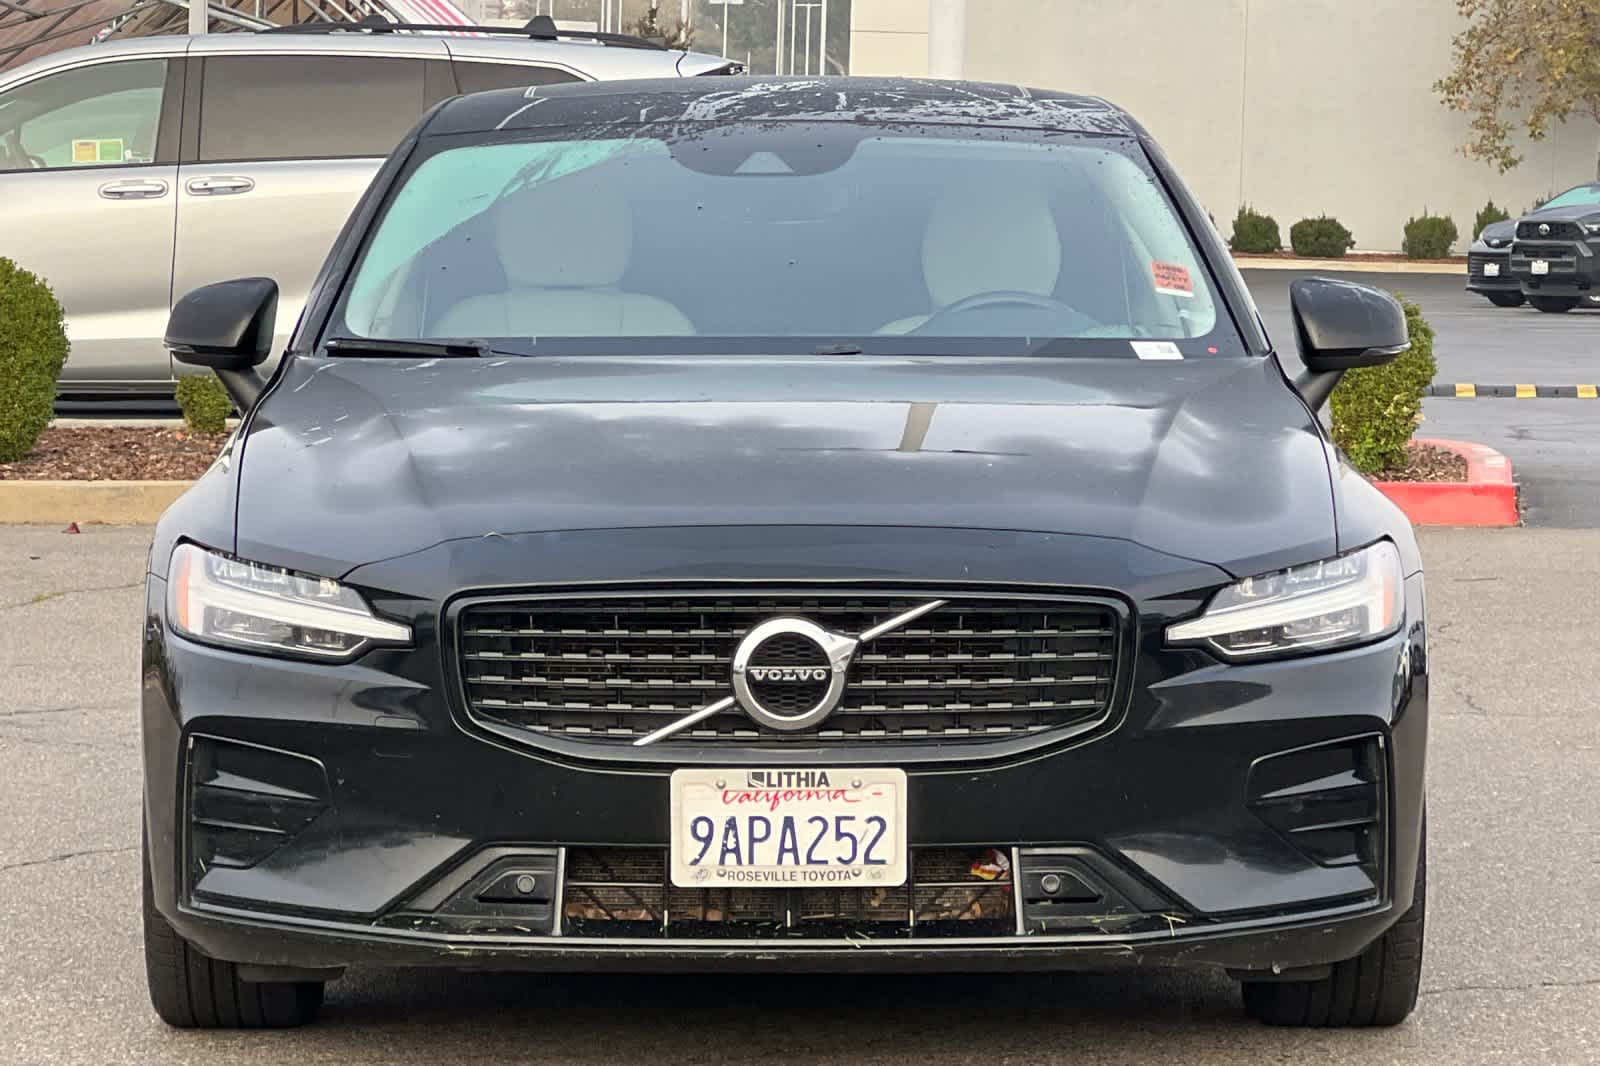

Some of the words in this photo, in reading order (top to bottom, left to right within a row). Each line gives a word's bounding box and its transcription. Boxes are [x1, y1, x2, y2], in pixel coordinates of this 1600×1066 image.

[750, 669, 827, 681] VOLVO
[766, 771, 830, 788] LITHIA
[689, 815, 888, 866] 9APA252
[727, 870, 797, 882] ROSEVILLE
[801, 870, 852, 881] TOYOTA
